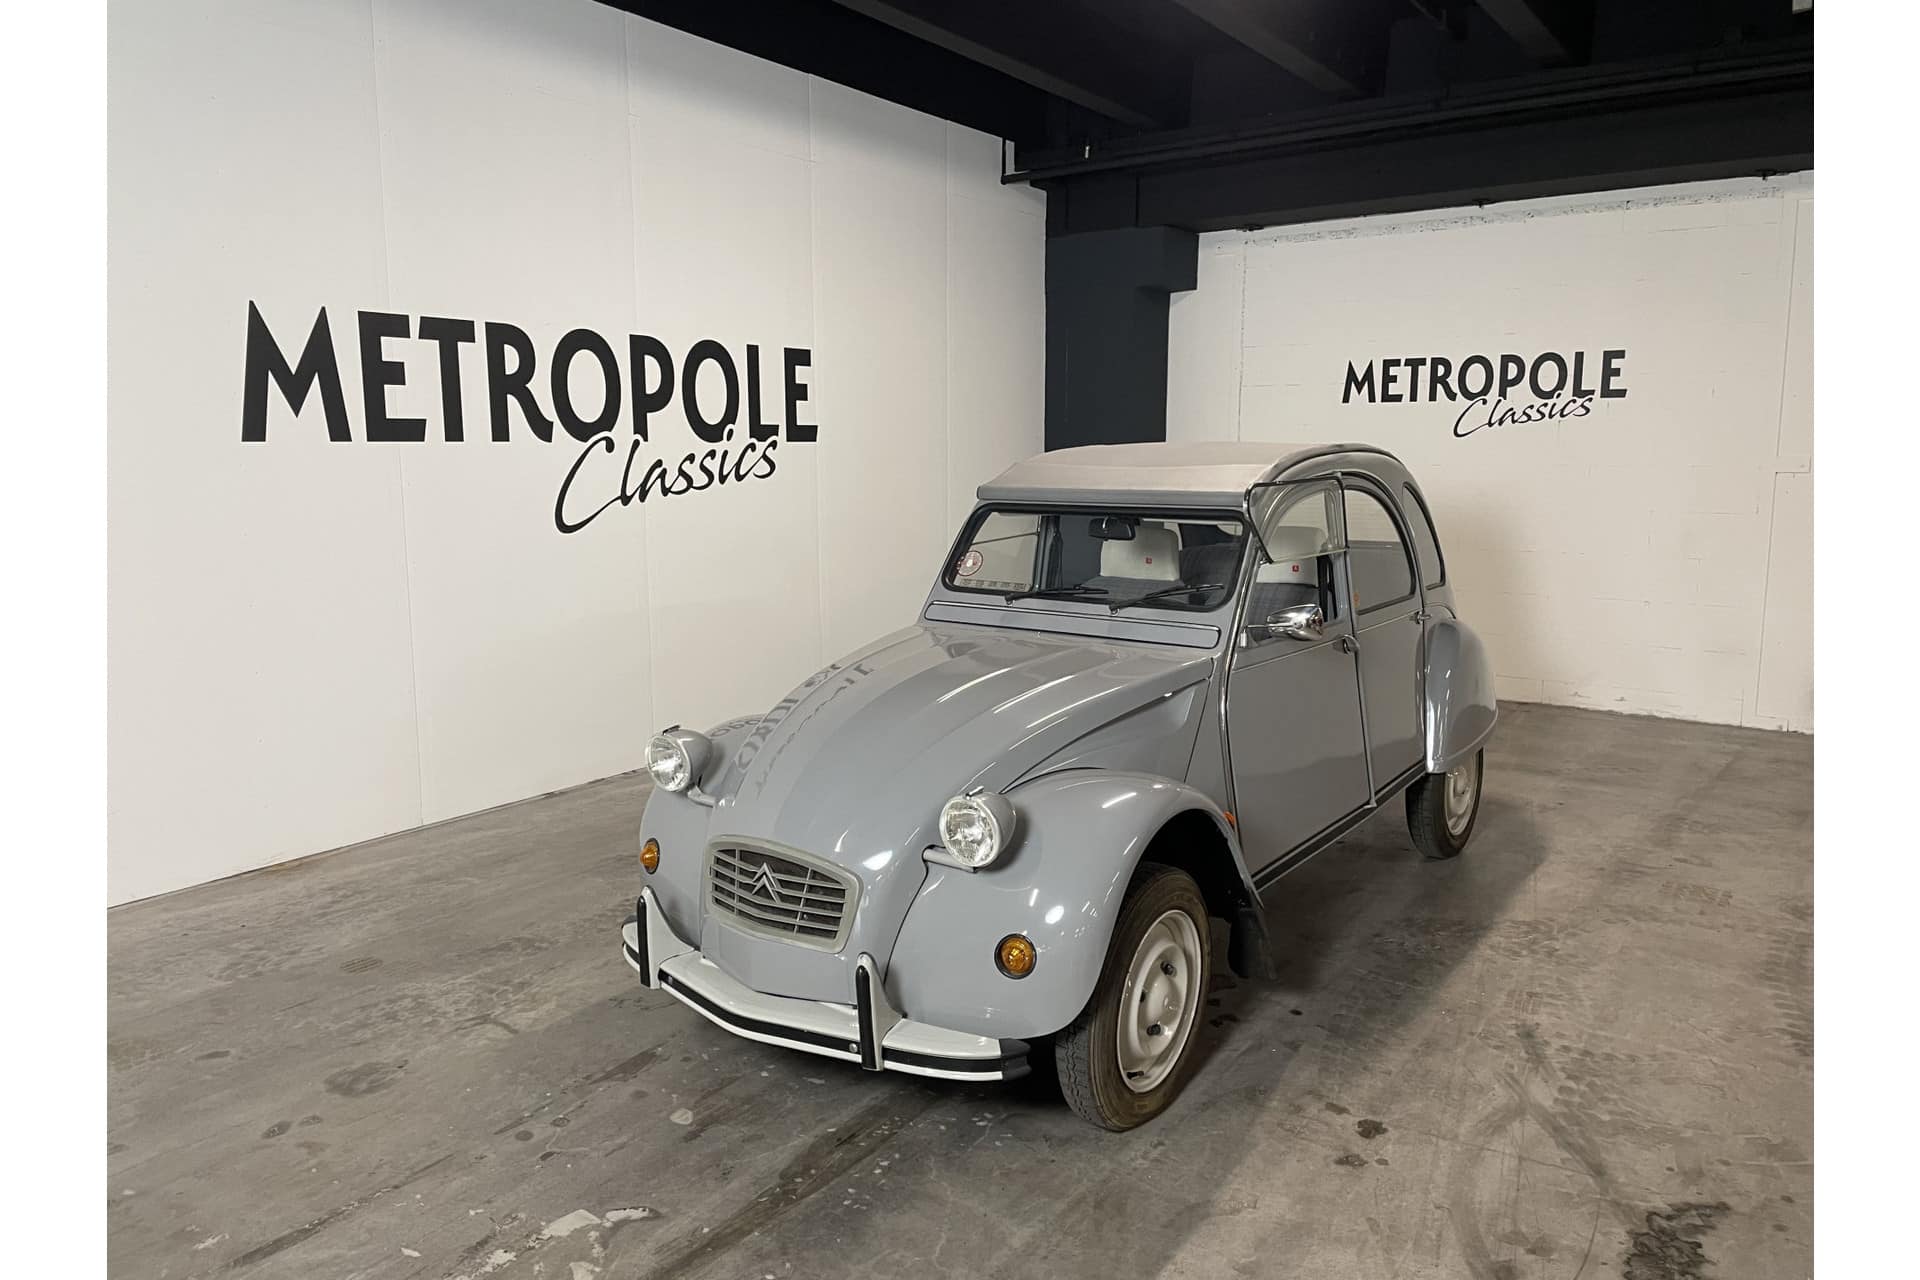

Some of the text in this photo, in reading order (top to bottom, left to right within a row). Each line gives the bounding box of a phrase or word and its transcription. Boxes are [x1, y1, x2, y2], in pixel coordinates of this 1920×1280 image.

[242, 300, 818, 442] METROPOLE
[1342, 350, 1628, 403] METROPOLE
[1453, 392, 1594, 438] Classics
[555, 427, 779, 534] Classics
